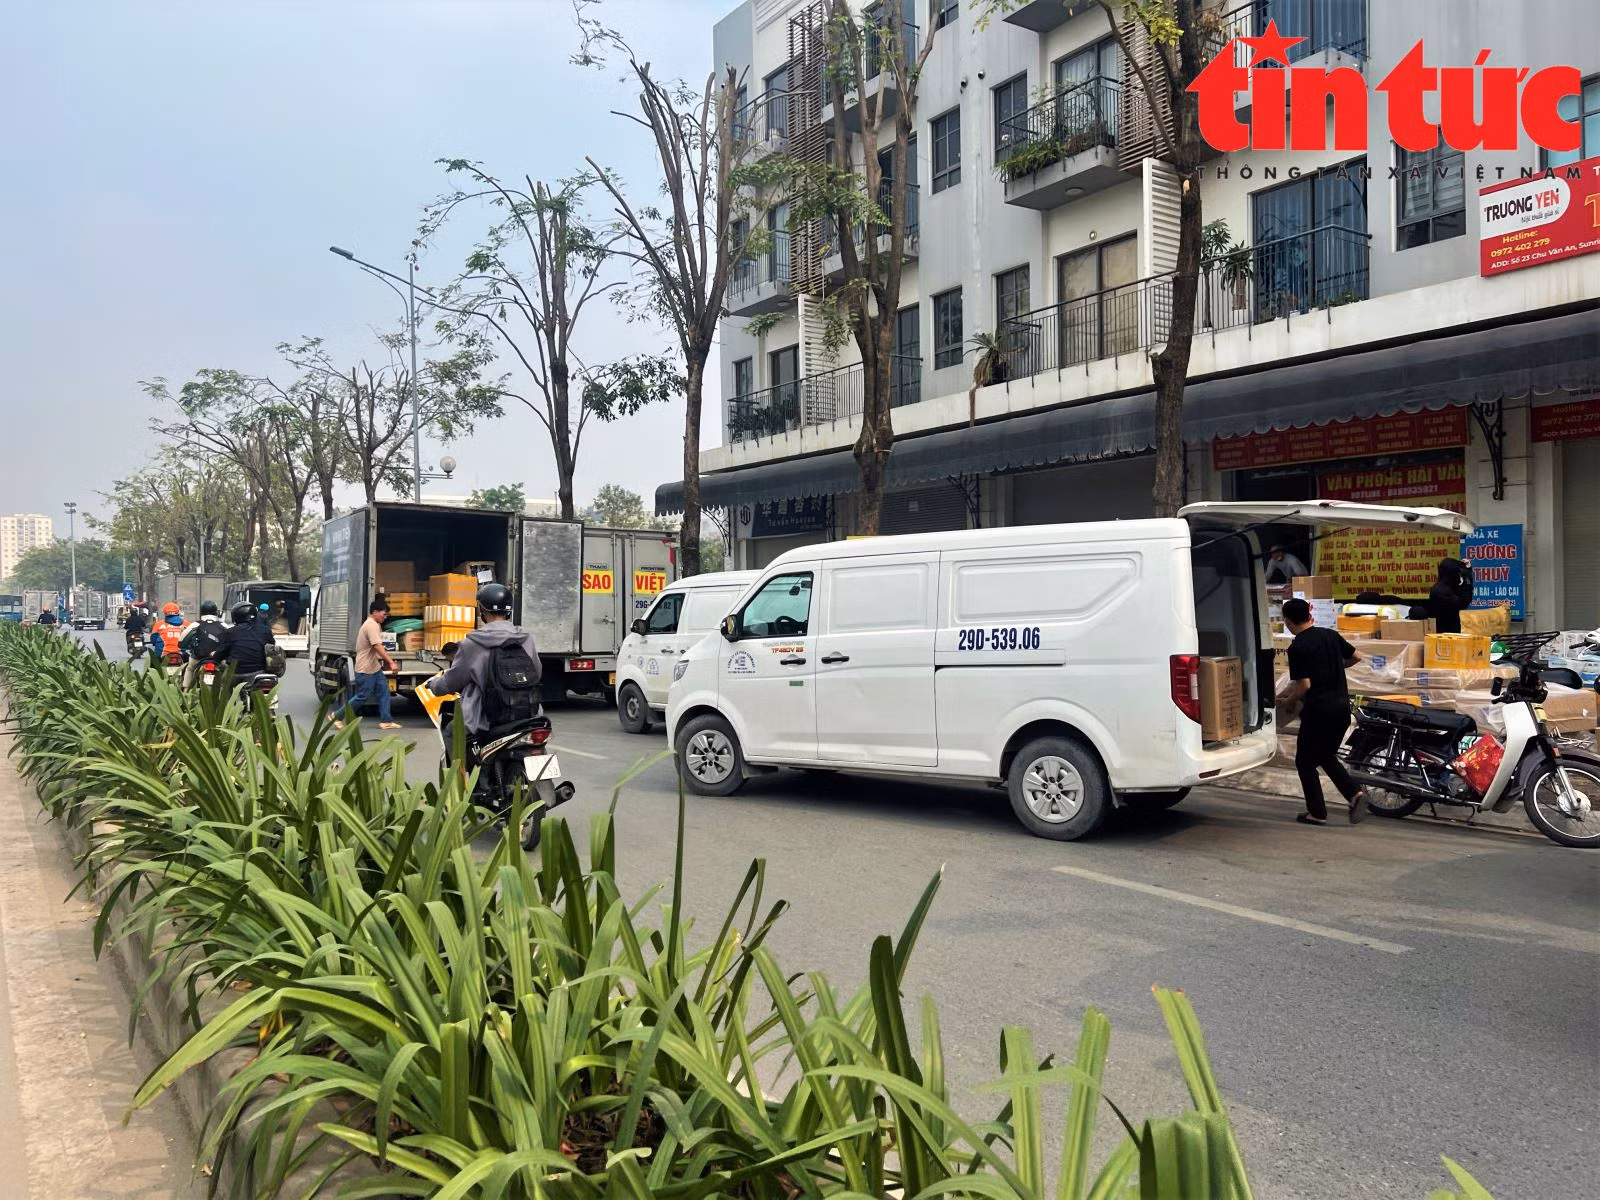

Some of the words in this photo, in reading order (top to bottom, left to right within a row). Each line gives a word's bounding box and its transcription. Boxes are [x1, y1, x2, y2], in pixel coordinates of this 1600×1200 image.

[1502, 230, 1539, 244] Hotline:
[1491, 248, 1513, 258] 0972
[1514, 242, 1532, 251] 402
[1533, 237, 1551, 246] 279
[1531, 251, 1547, 260] Chu
[1487, 530, 1499, 539] XE
[583, 574, 611, 590] SAO
[635, 572, 665, 594] VIỆT
[958, 627, 1041, 651] 29D-539.06
